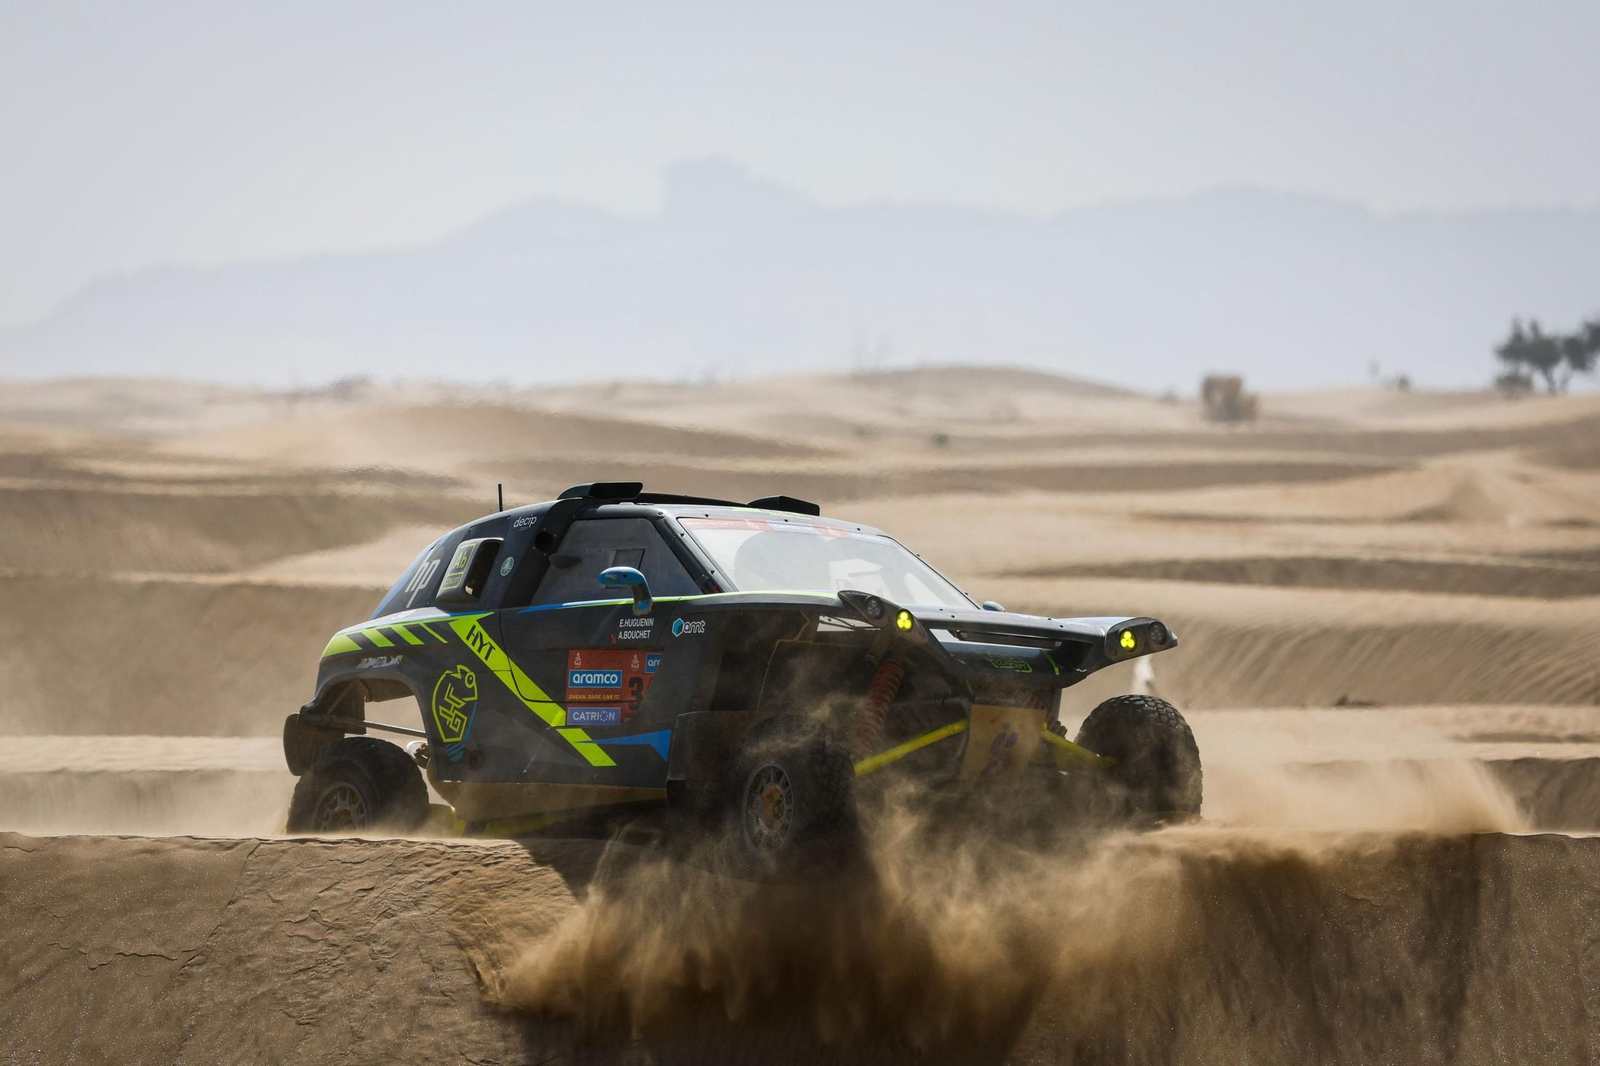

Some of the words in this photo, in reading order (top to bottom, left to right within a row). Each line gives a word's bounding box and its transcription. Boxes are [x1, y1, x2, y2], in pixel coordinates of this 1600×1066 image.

[404, 551, 441, 609] hp
[619, 618, 654, 628] E.HUGUENIN
[618, 630, 651, 640] A.BOUCHET
[465, 624, 496, 662] HYT
[572, 673, 619, 684] aramco
